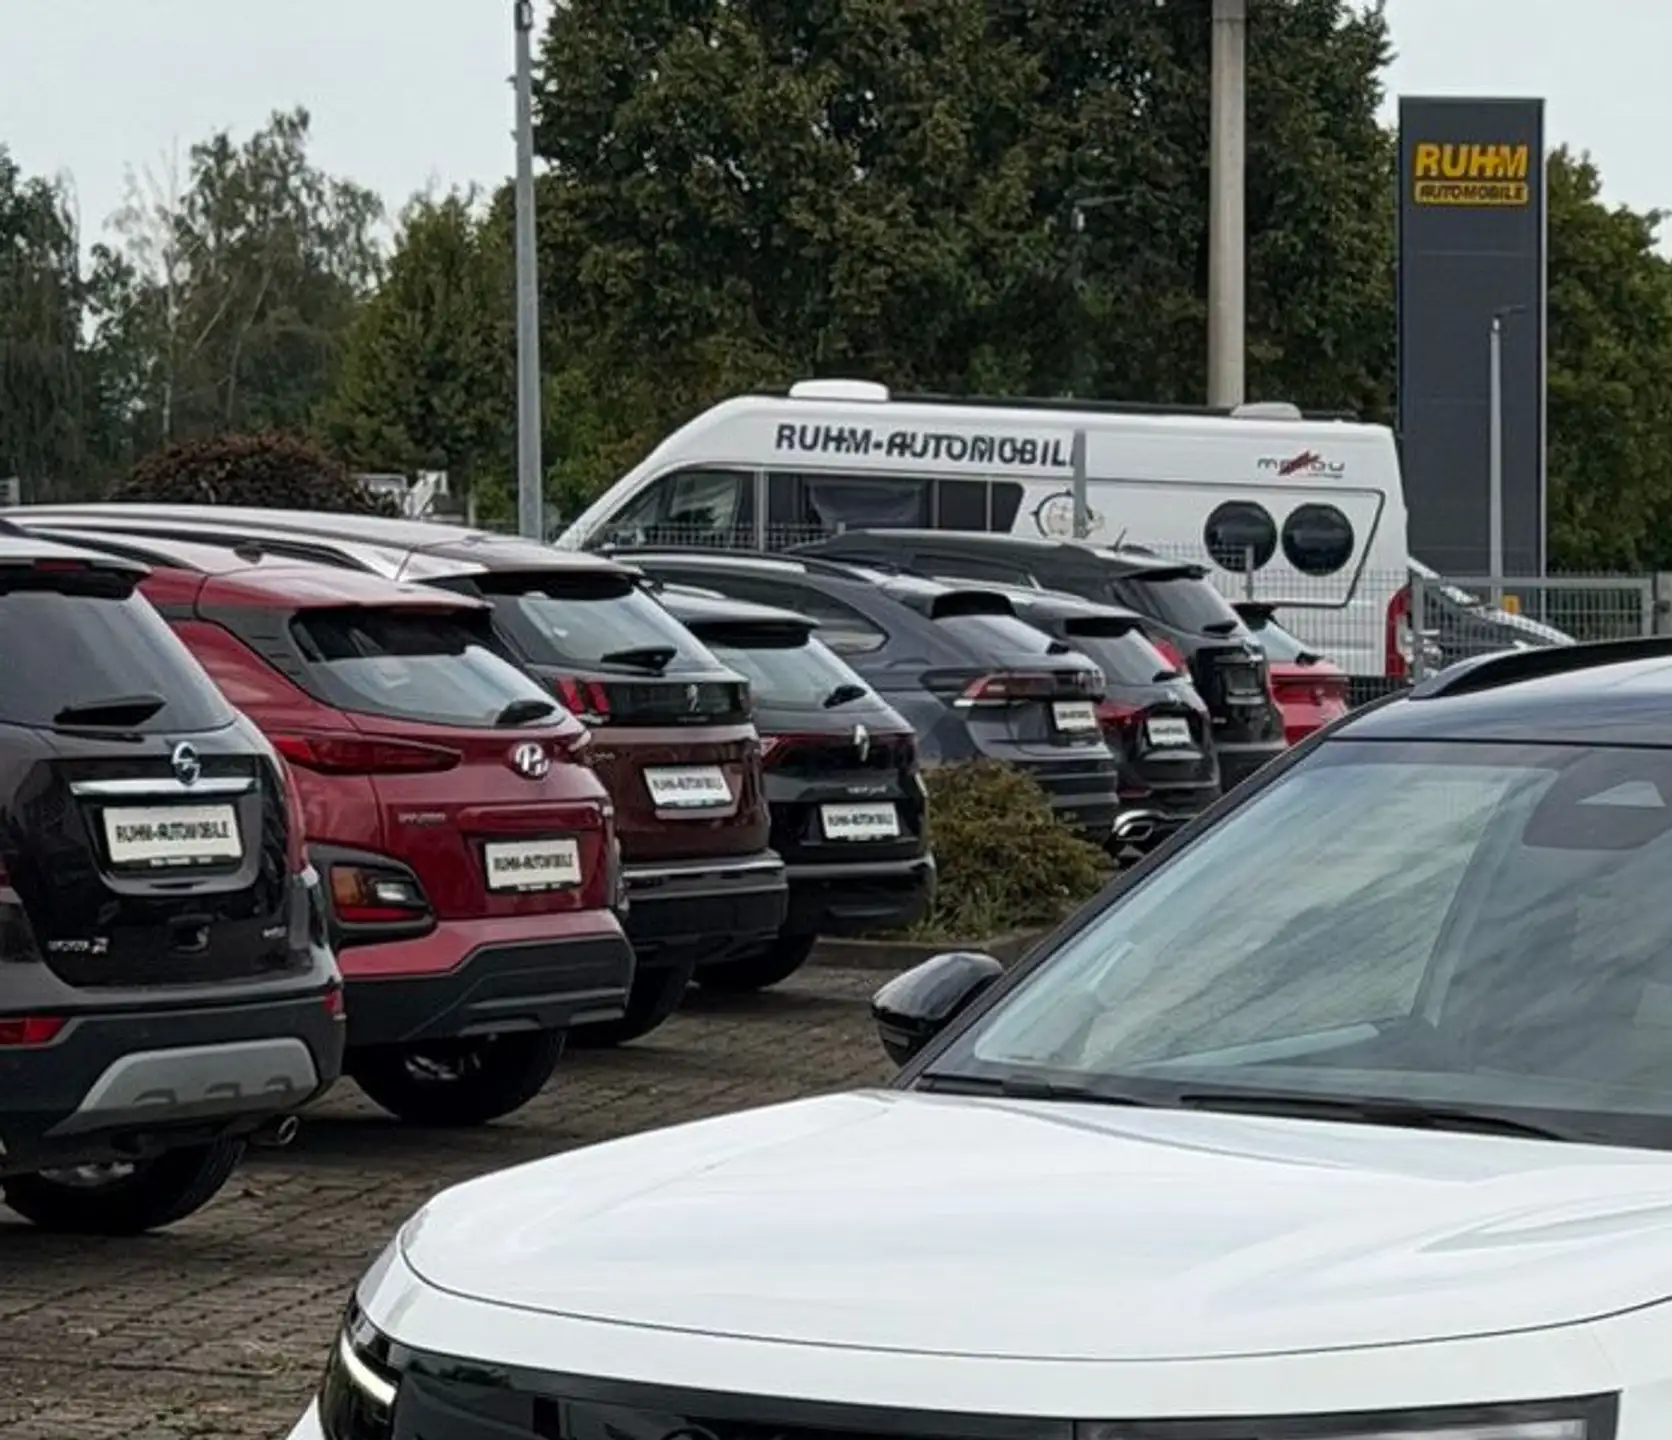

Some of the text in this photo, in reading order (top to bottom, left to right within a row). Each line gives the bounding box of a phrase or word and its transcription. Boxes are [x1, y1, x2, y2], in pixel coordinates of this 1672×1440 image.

[1415, 143, 1528, 177] RUHM
[1419, 183, 1524, 200] AUTOMOBILE
[775, 423, 1076, 468] RUHM-AUTOMOBIL
